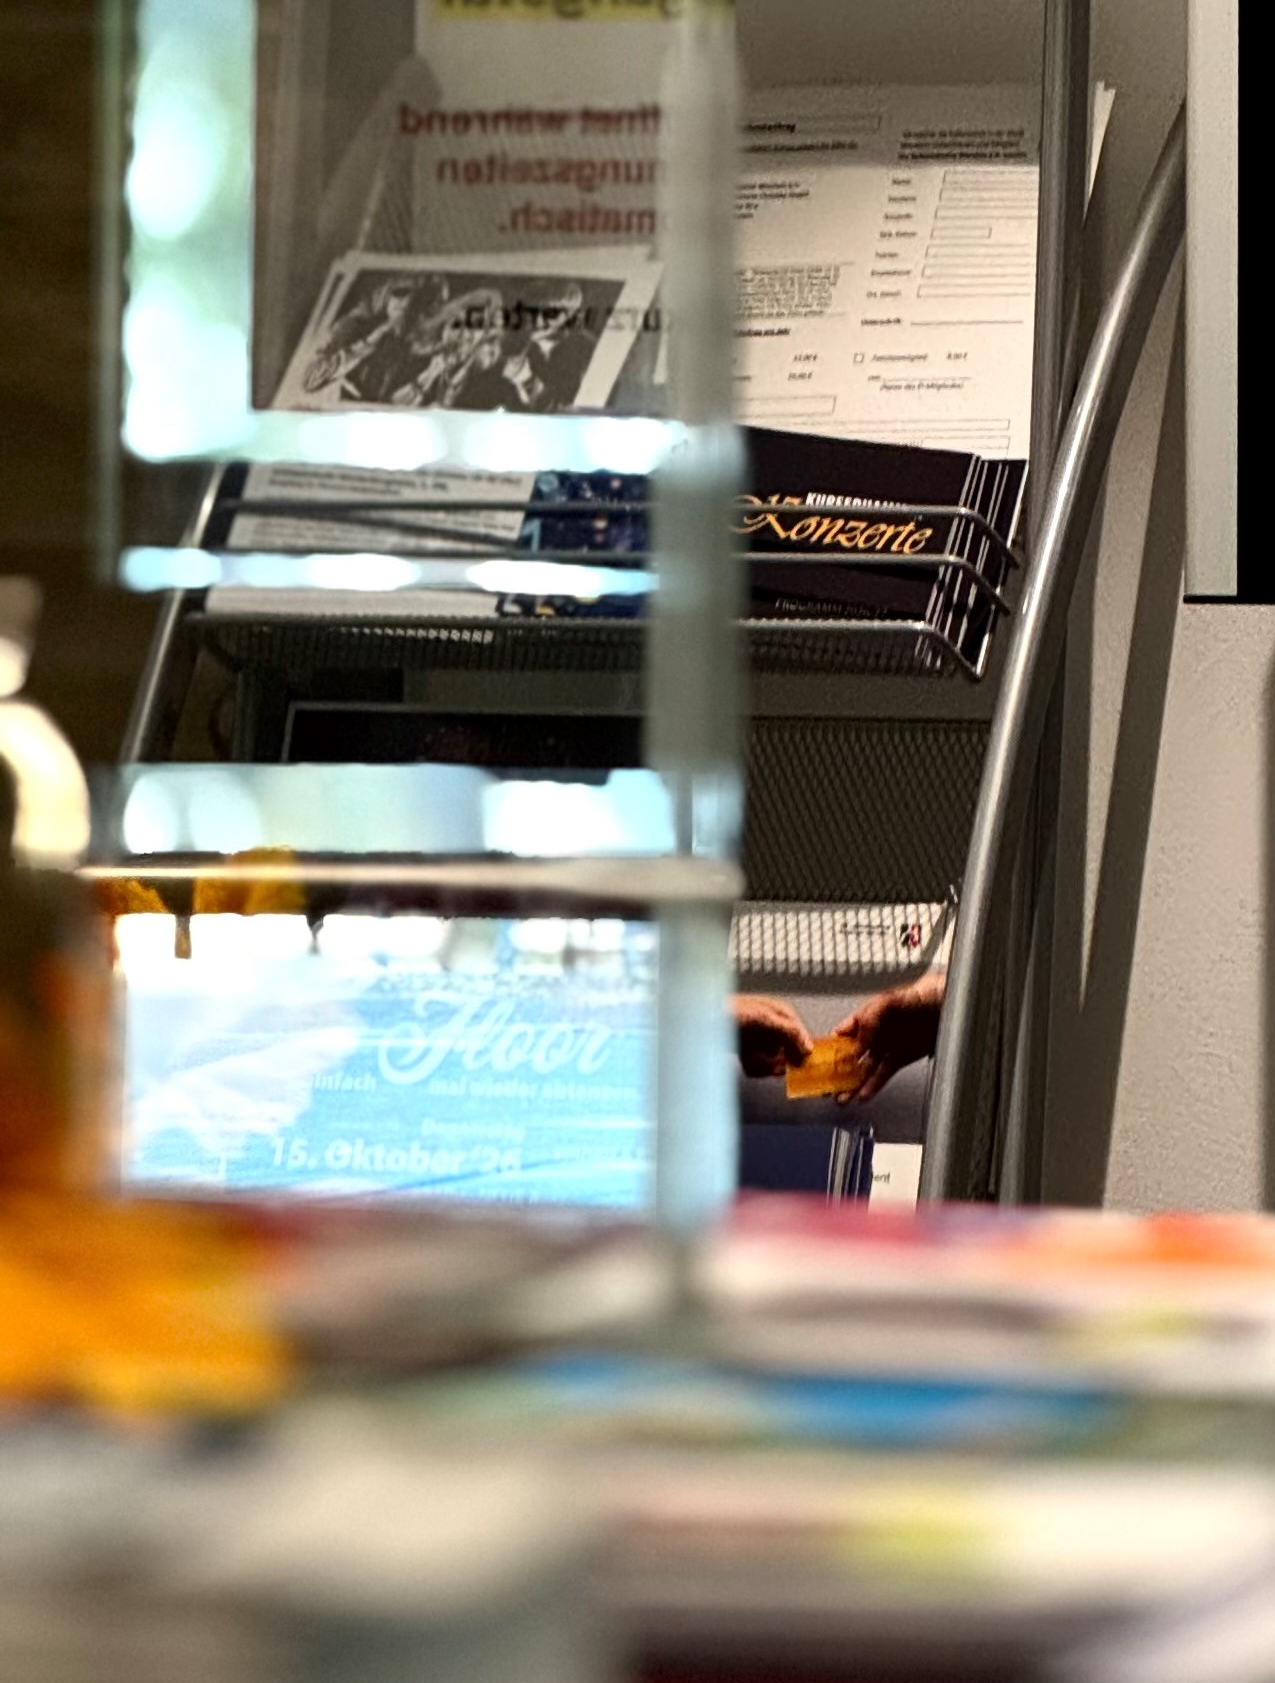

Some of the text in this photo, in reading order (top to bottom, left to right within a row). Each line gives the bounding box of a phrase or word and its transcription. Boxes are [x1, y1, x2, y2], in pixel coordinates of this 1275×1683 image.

[732, 493, 932, 555] Konzerte
[271, 1137, 317, 1169] 15.
[325, 1139, 466, 1175] Oktober
